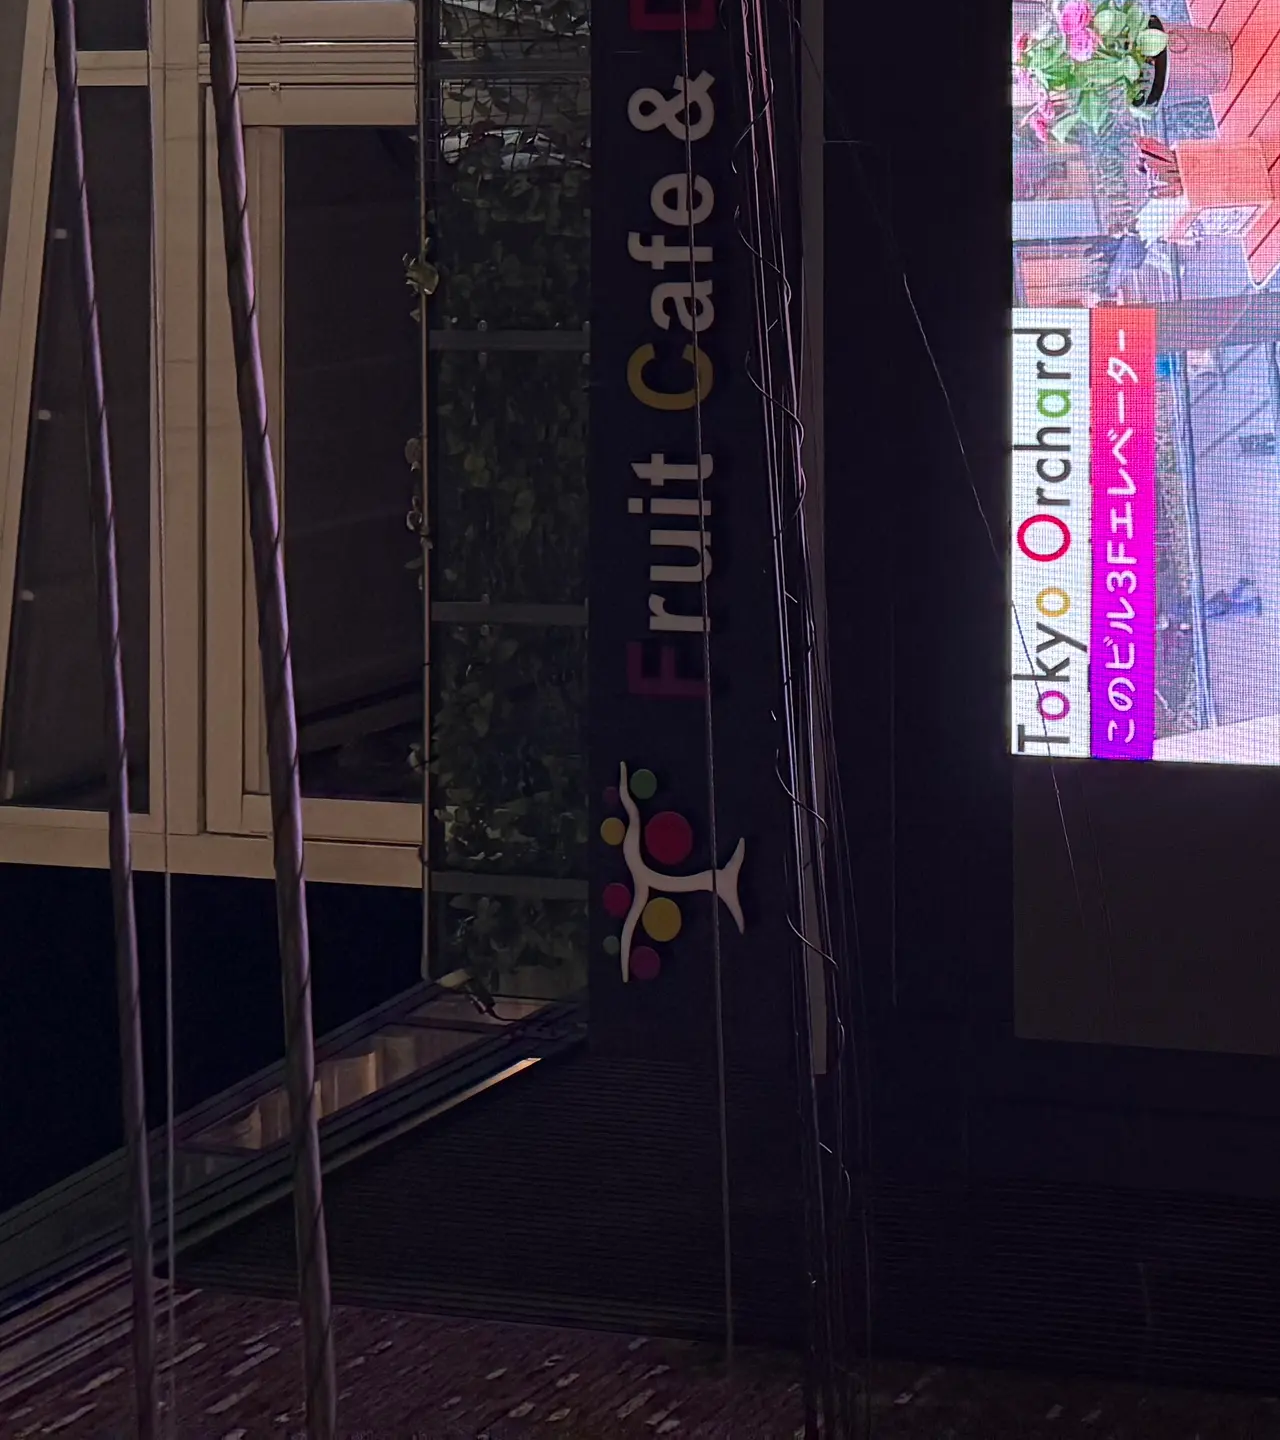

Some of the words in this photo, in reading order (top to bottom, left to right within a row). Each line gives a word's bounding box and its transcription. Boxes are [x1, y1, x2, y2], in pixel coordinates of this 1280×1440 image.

[627, 71, 716, 141] &
[626, 172, 715, 411] Cafe
[1014, 326, 1072, 562] Orchard
[1104, 329, 1139, 745] このビル3Fエレベーター
[626, 452, 714, 700] Fruit
[1016, 587, 1087, 753] Tokyo
